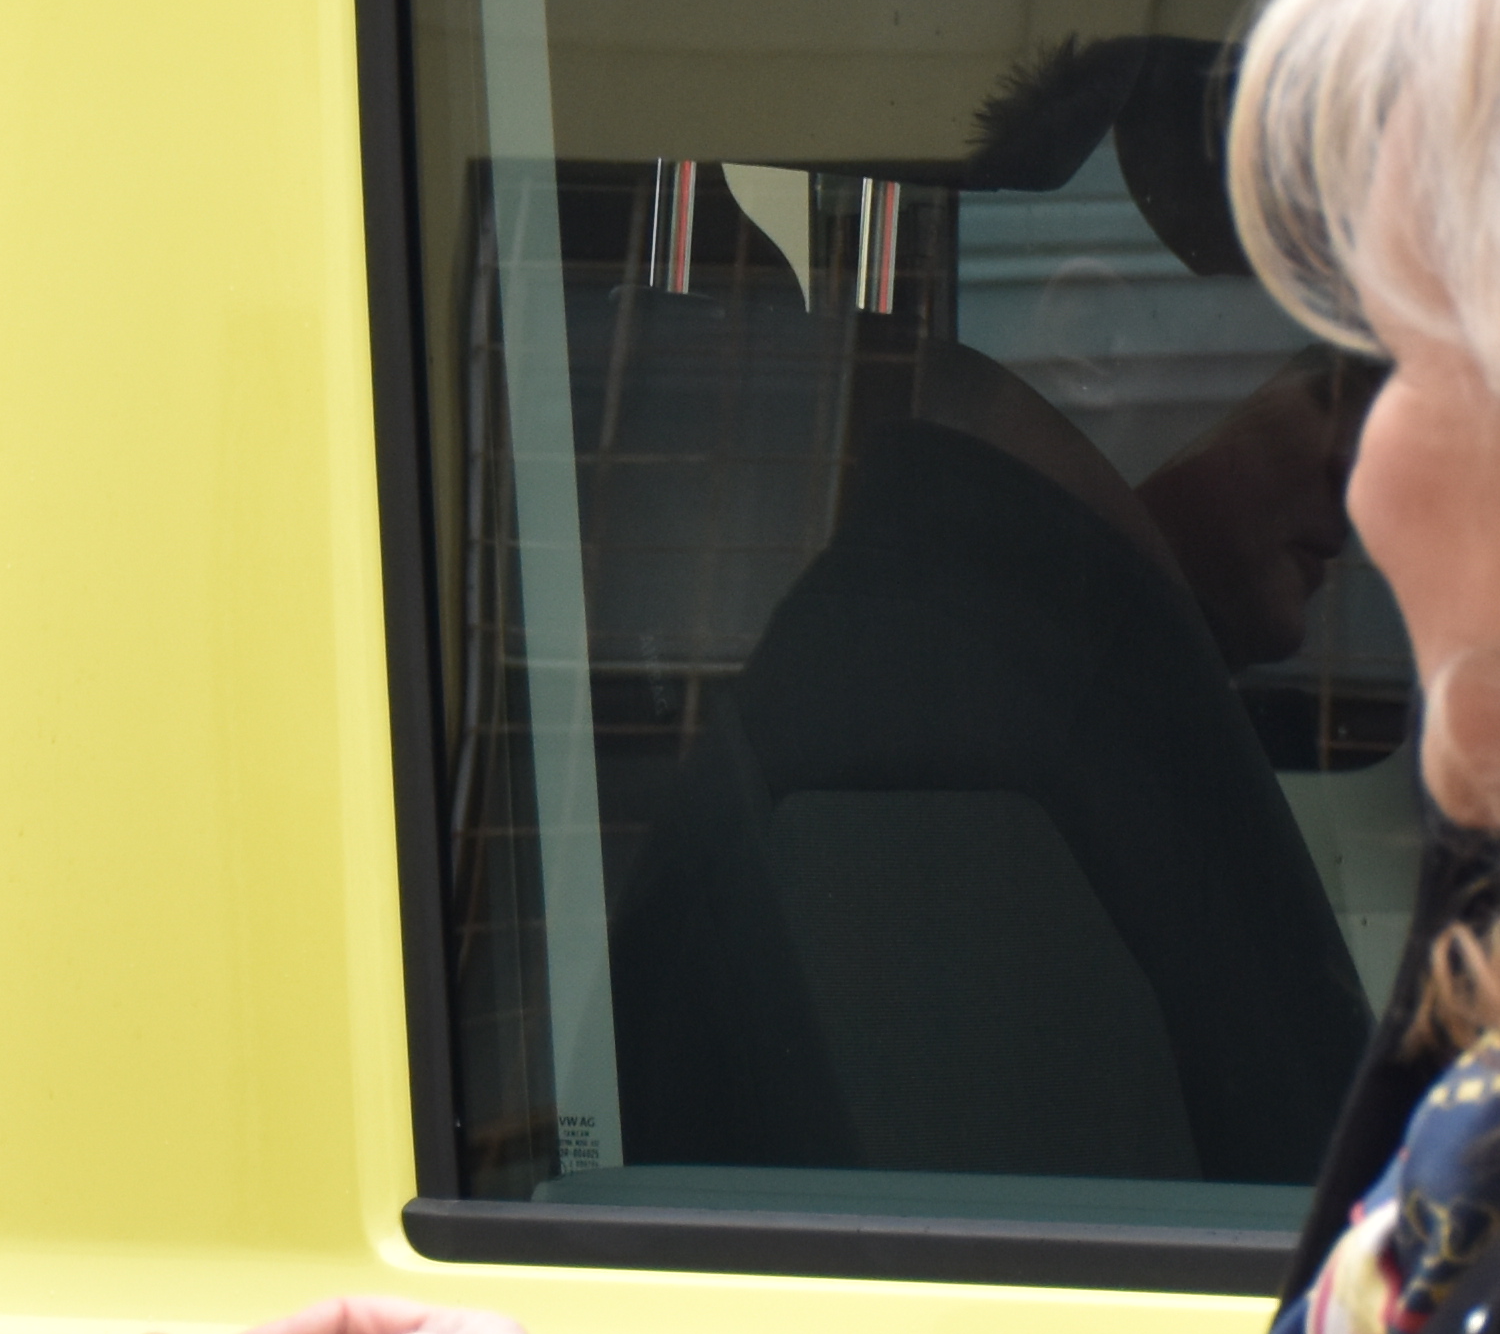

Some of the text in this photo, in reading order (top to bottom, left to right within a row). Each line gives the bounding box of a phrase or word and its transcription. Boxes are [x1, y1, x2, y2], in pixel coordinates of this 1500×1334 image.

[639, 635, 668, 717] AIRBAG
[559, 1116, 595, 1128] VW AG
